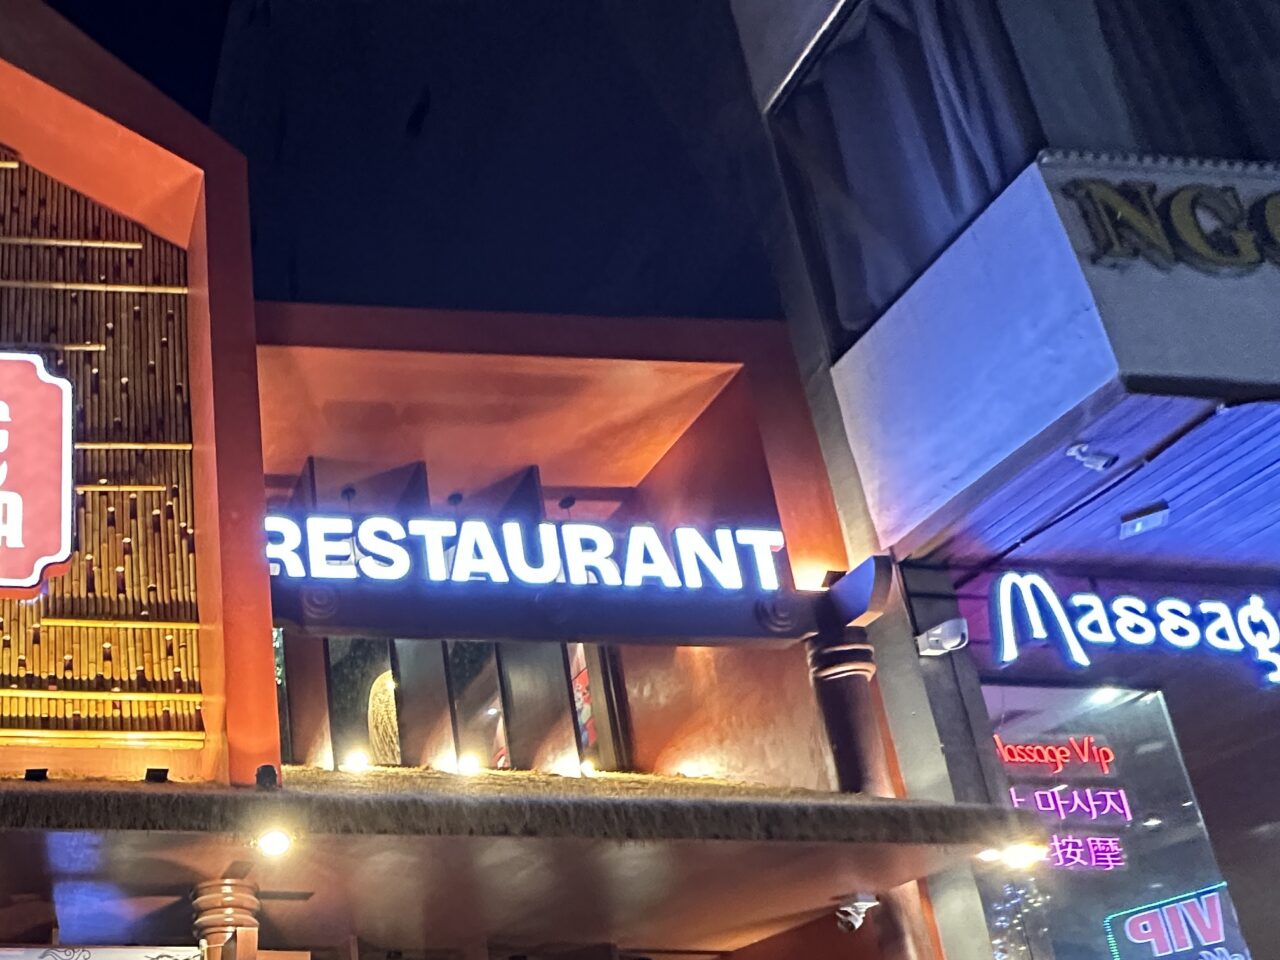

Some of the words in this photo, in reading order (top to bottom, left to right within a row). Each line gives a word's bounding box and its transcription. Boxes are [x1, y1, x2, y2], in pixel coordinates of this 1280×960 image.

[264, 515, 784, 591] RESTAURANT
[1069, 735, 1116, 775] Vip
[1034, 788, 1133, 821] 마사지
[1051, 834, 1126, 871] 按摩
